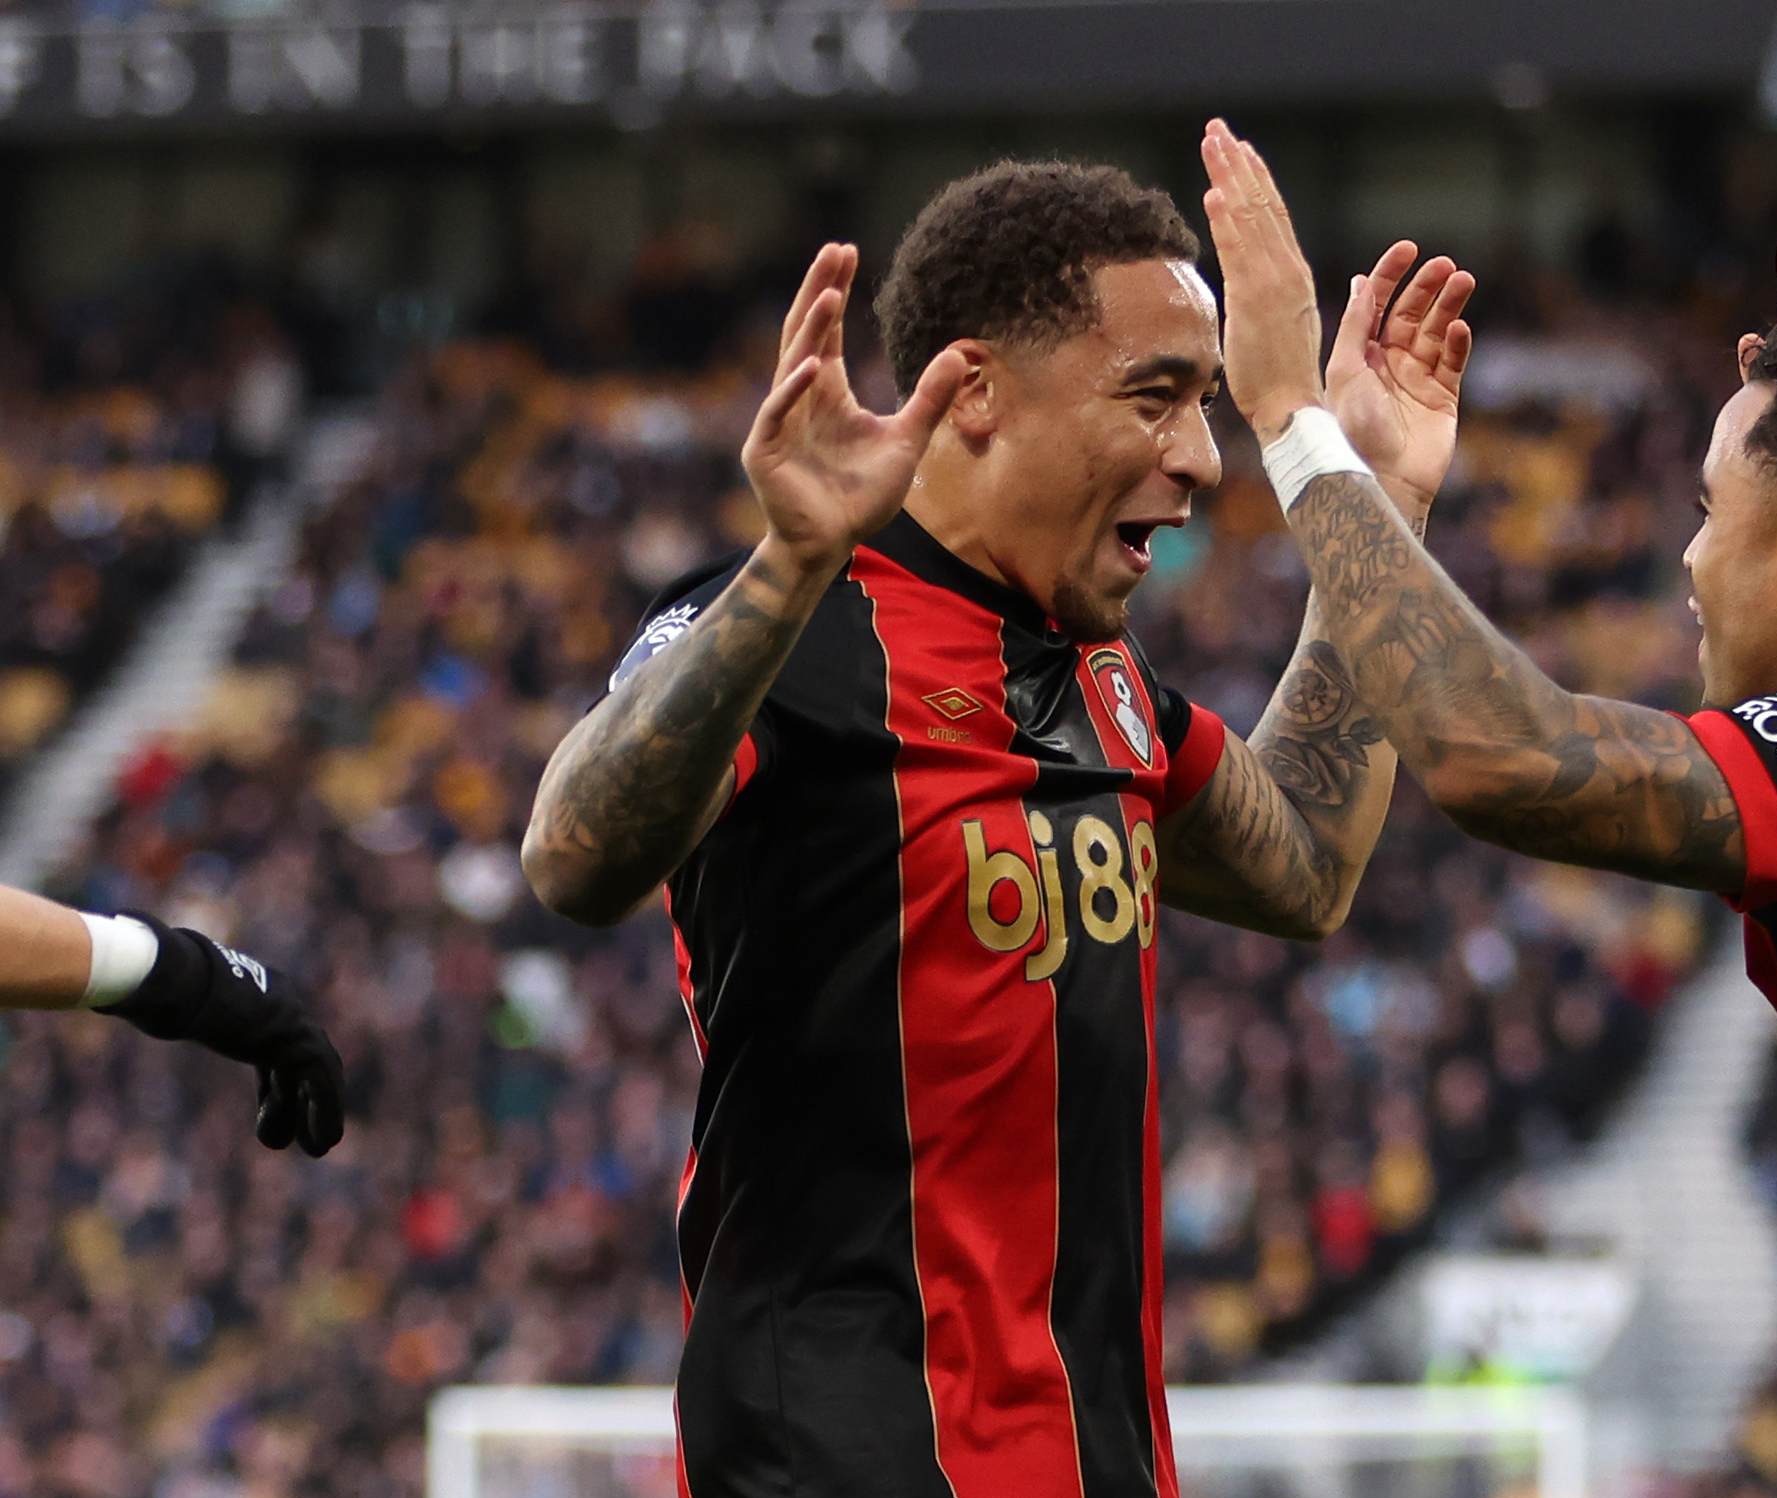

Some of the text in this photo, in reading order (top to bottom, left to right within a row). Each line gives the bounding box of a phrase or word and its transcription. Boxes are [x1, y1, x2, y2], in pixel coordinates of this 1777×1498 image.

[74, 14, 195, 119] IS
[228, 12, 365, 114] IN
[402, 4, 604, 106] THE
[636, 0, 920, 98] PACK
[961, 810, 1159, 982] bj88
